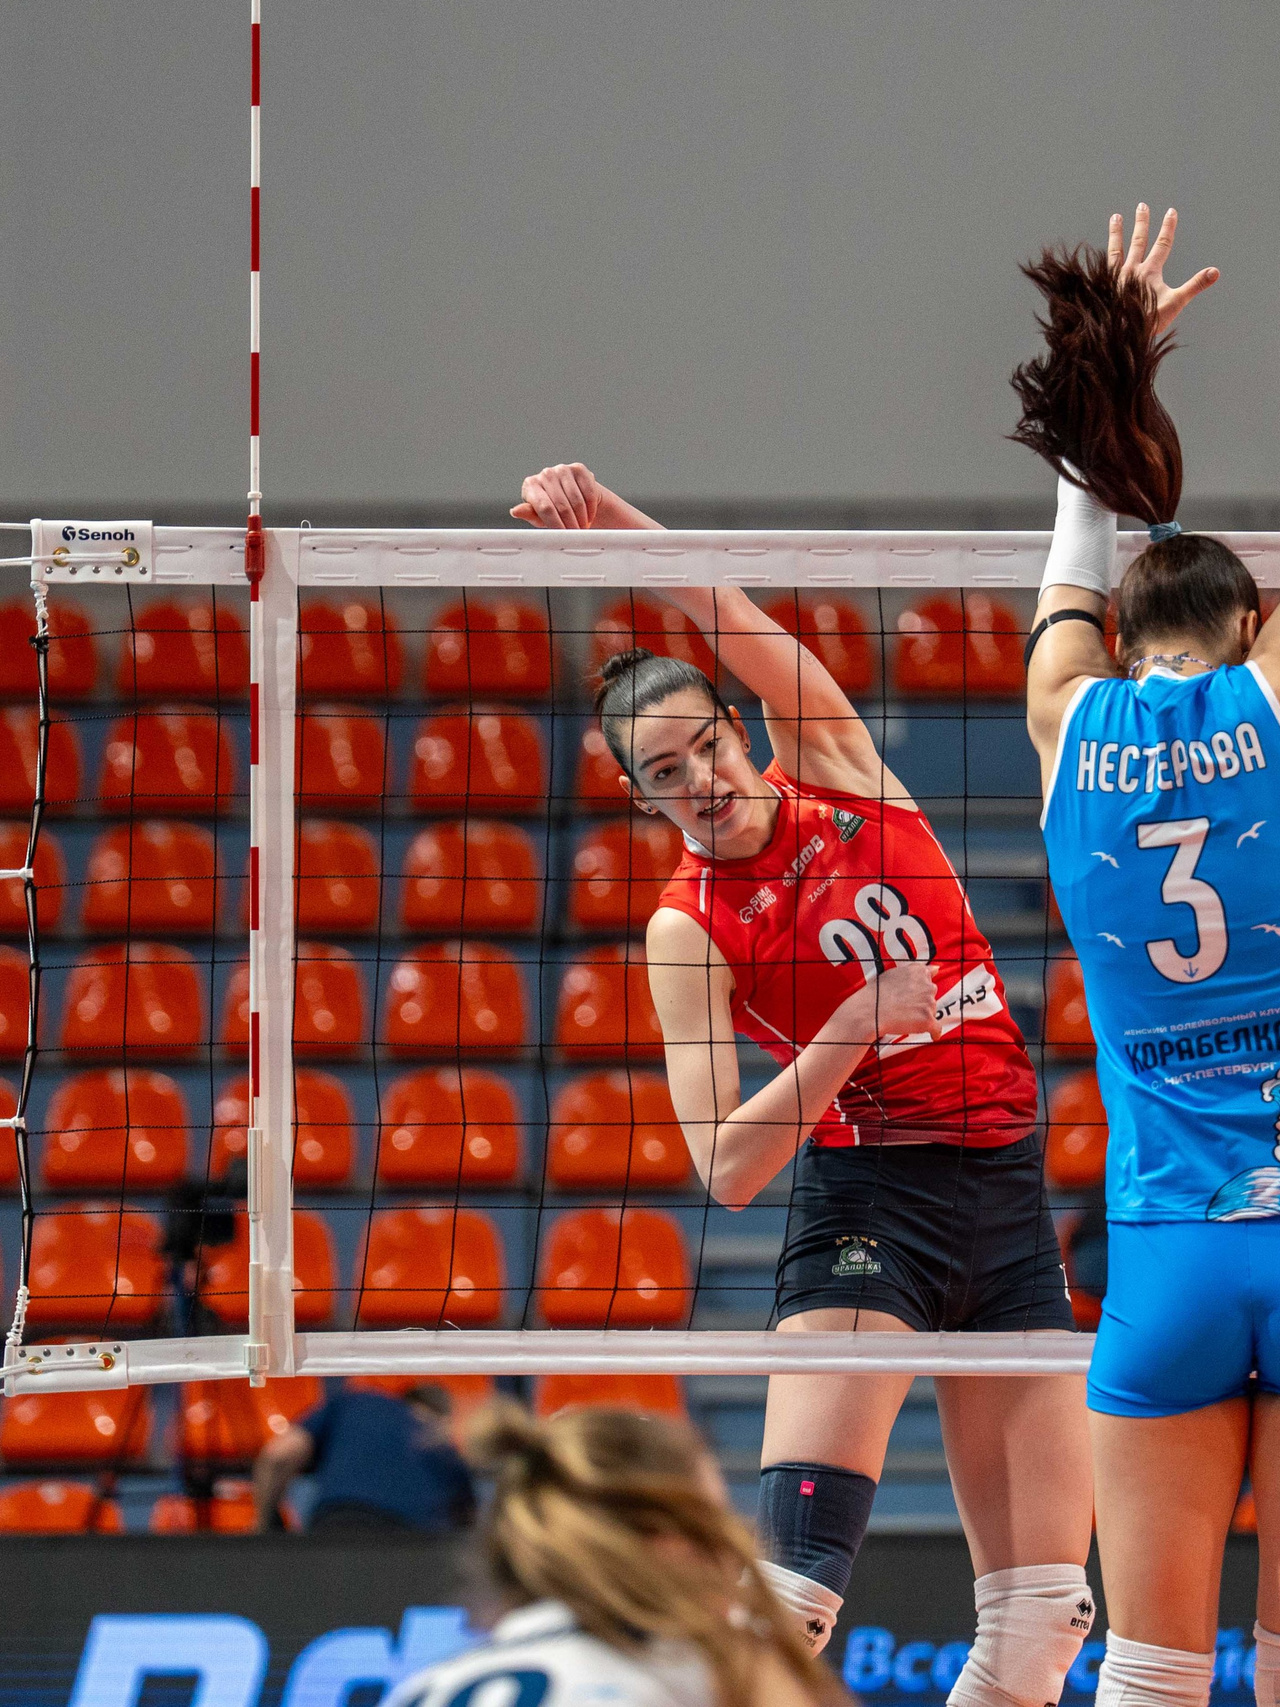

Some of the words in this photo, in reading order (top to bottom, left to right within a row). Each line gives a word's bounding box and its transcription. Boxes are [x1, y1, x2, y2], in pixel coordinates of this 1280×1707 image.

[78, 528, 135, 541] Senoh
[1076, 722, 1267, 794] НЕСТЕРОВА
[750, 886, 772, 908] SIMA
[808, 869, 840, 903] ZASPORT
[755, 893, 777, 914] LAND
[1136, 816, 1230, 985] 3
[819, 883, 937, 982] 28
[1170, 1010, 1257, 1033] ВОЛЕЙБОЛЬНЫЙ
